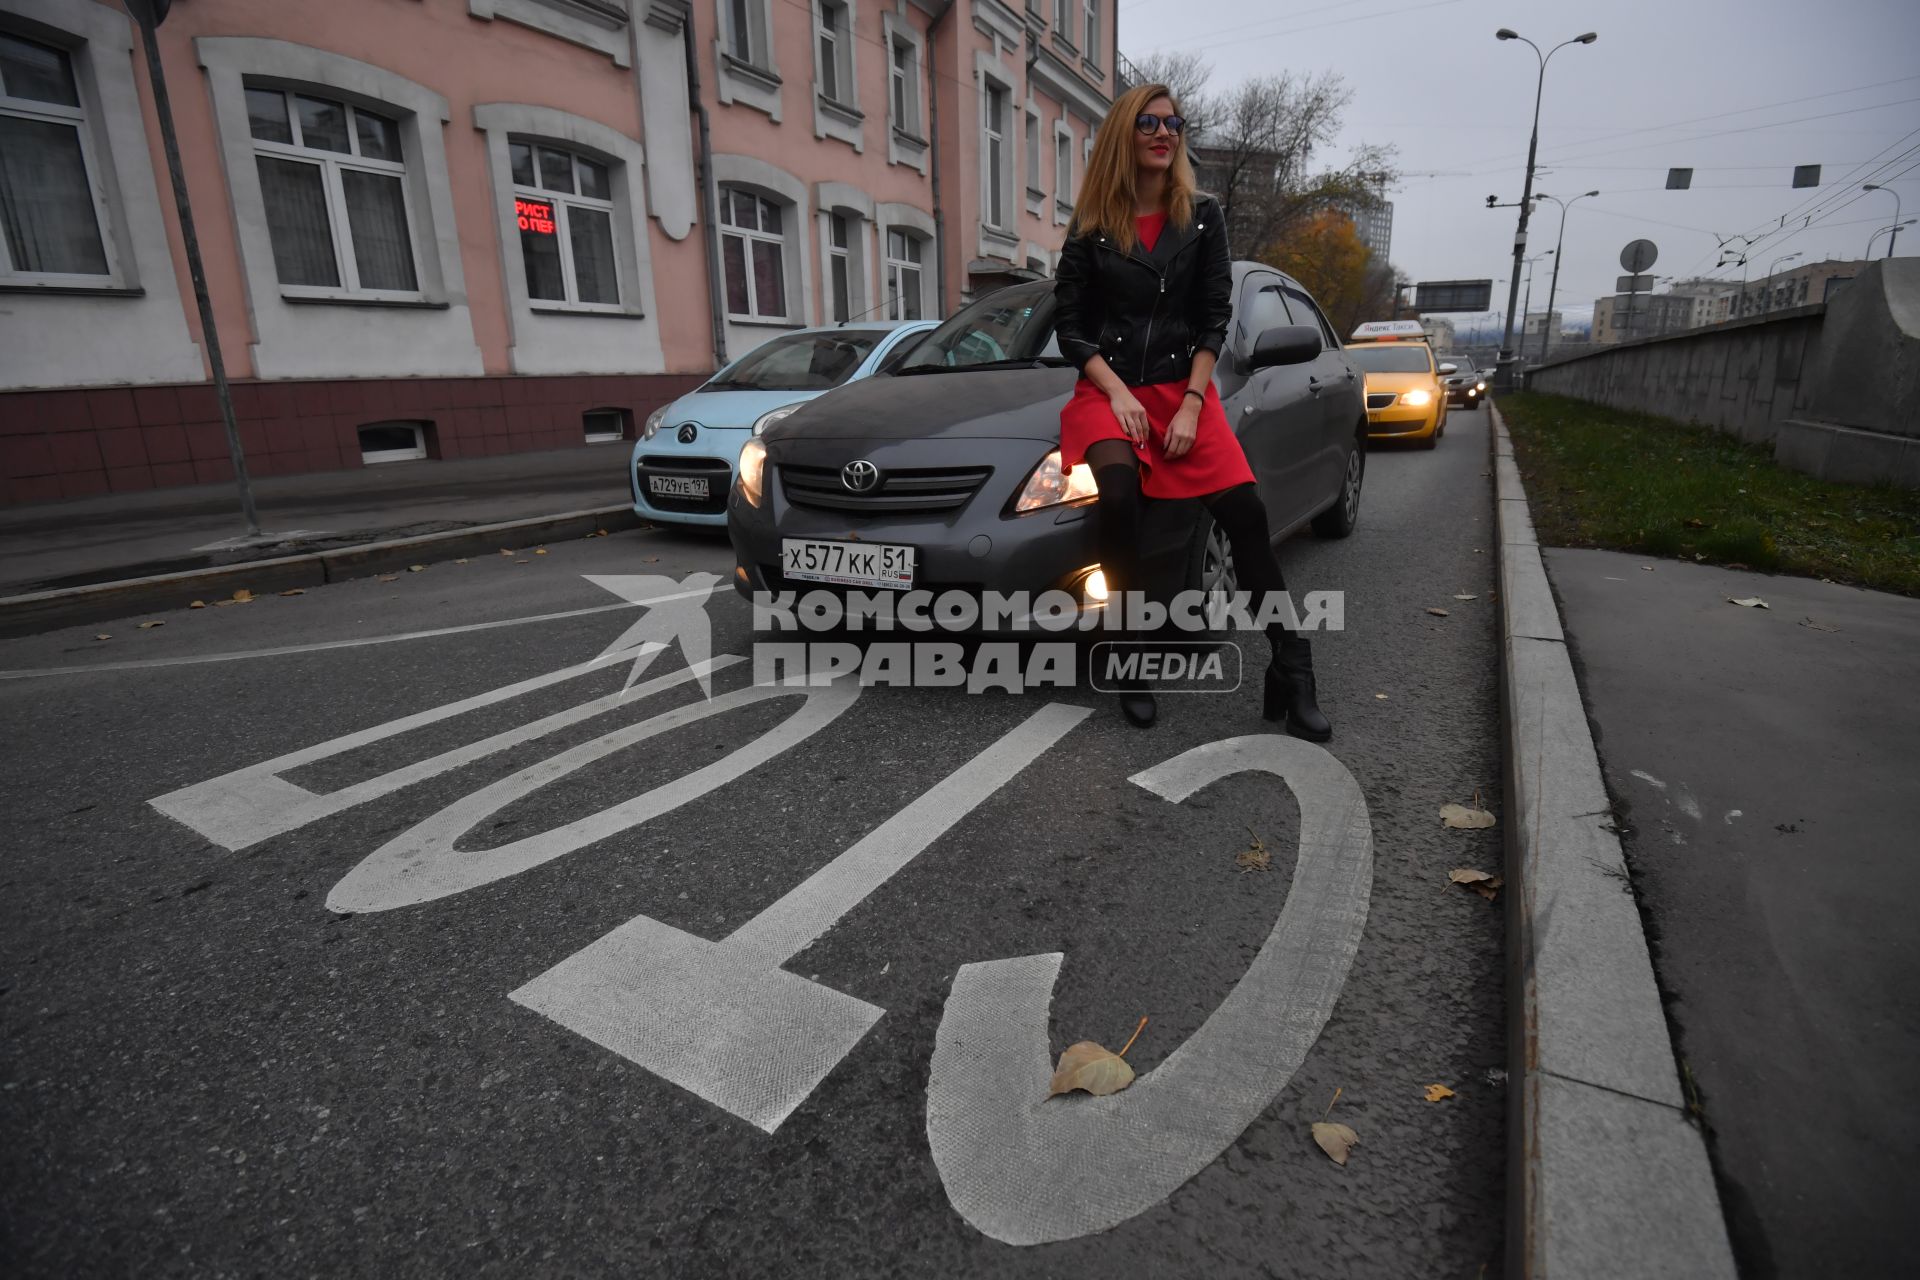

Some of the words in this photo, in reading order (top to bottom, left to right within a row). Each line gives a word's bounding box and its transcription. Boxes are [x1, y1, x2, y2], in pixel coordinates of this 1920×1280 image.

[1364, 324, 1390, 332] Яндекс
[883, 547, 906, 570] 51
[881, 569, 898, 579] RUS
